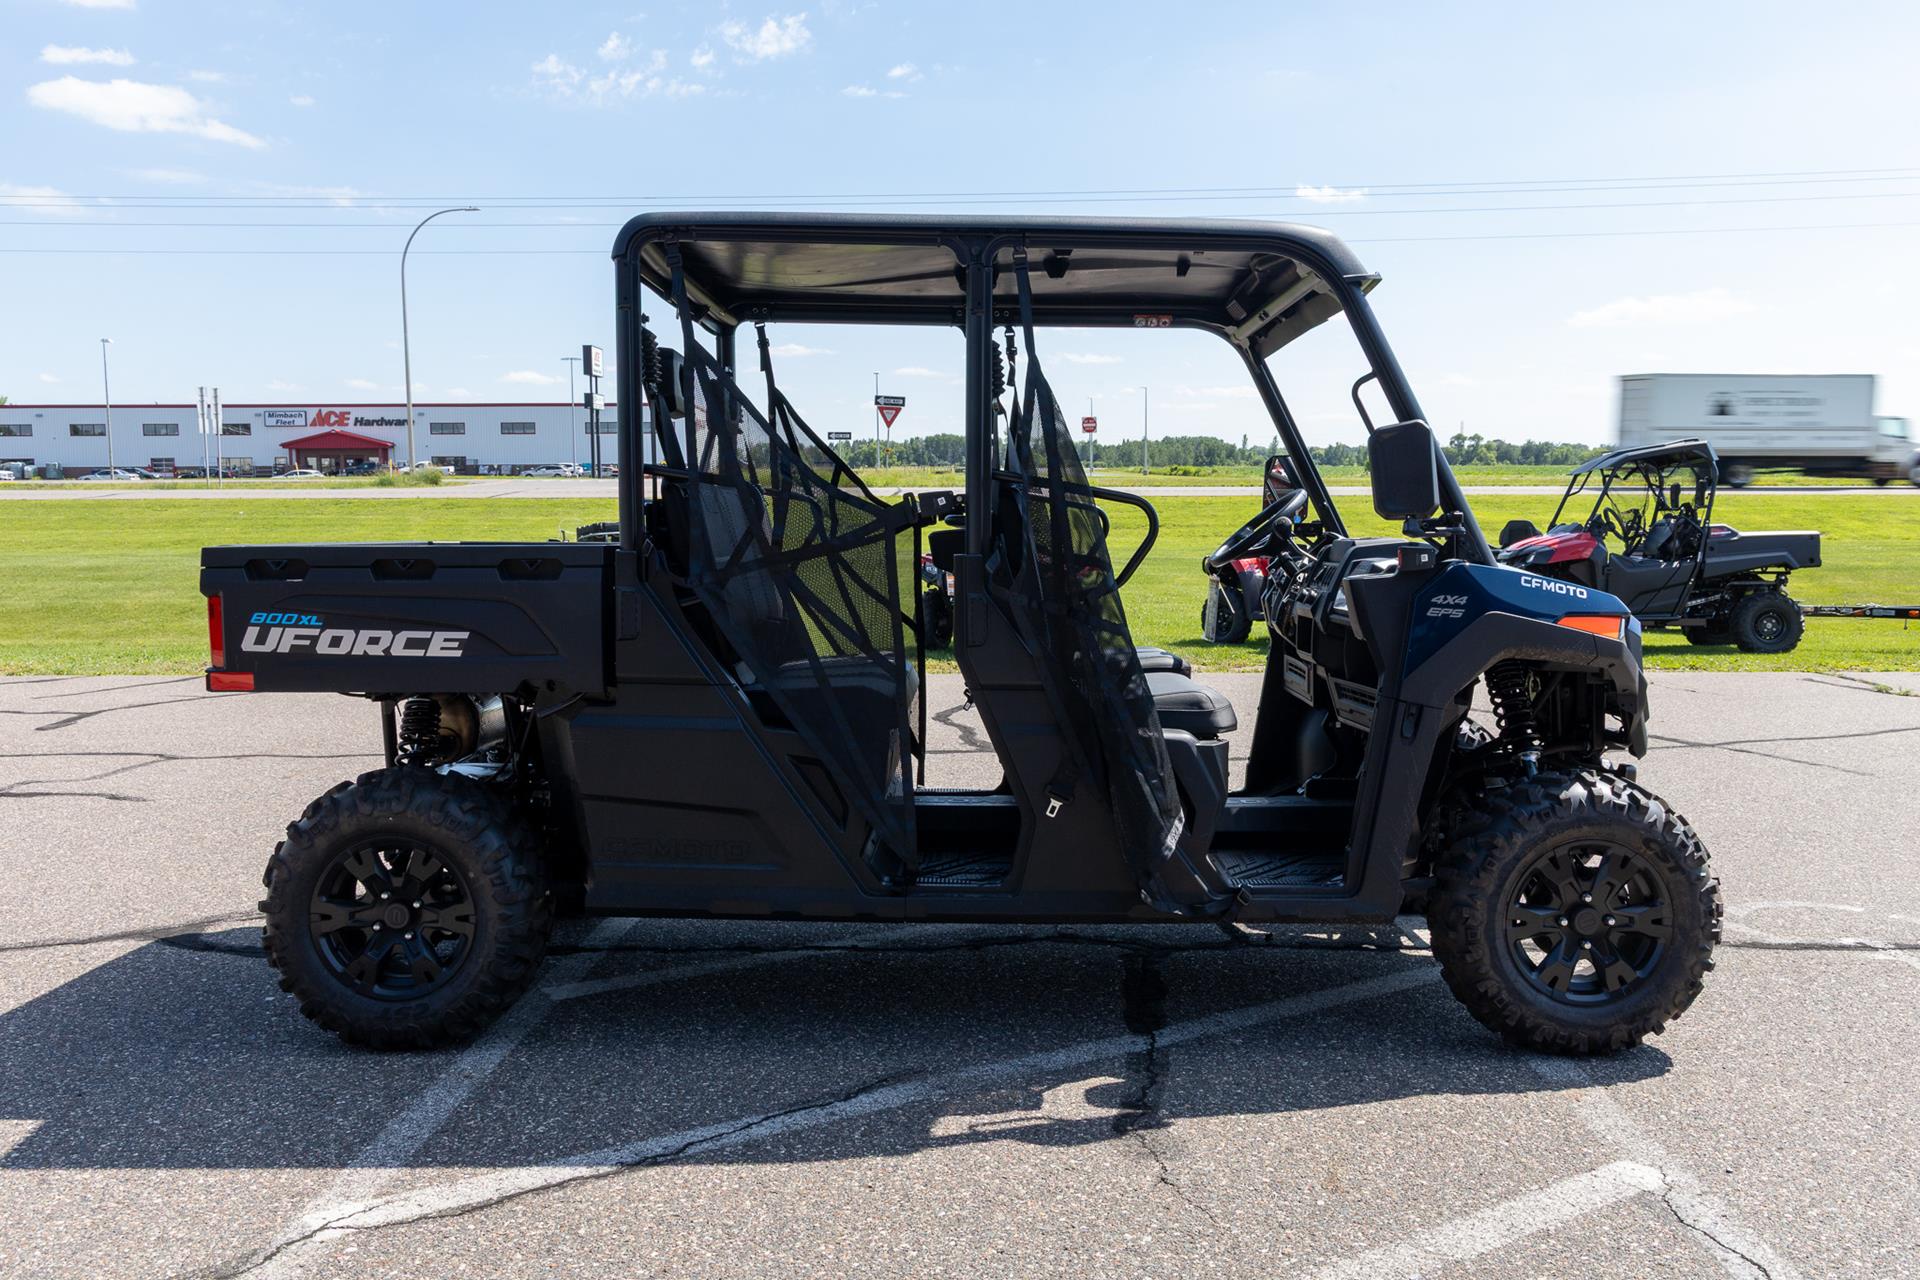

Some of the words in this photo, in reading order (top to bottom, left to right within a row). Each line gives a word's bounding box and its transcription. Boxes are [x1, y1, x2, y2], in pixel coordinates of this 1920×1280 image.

[309, 408, 351, 427] ACE
[353, 416, 415, 427] Hardwar
[1520, 575, 1588, 600] CFMOTO
[1431, 595, 1468, 605] 4X4
[1426, 607, 1466, 618] EPS
[240, 625, 470, 657] UFORCE
